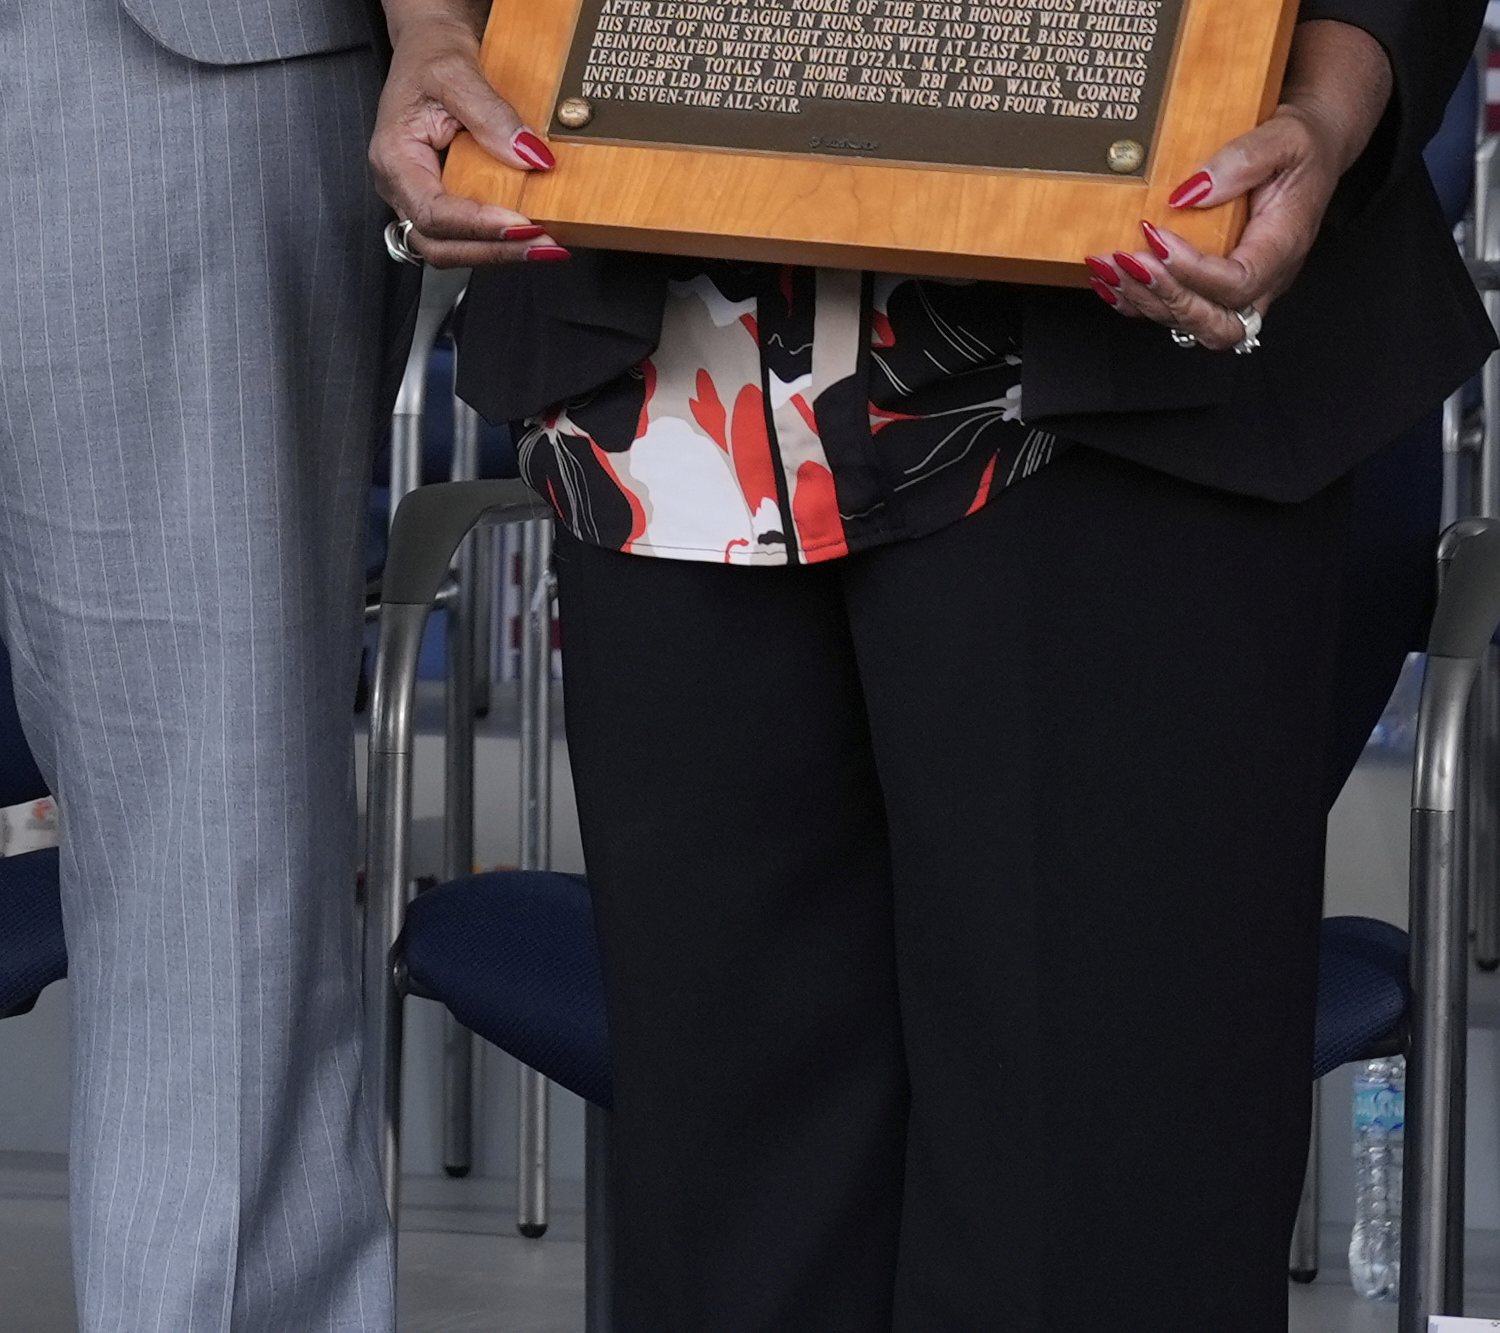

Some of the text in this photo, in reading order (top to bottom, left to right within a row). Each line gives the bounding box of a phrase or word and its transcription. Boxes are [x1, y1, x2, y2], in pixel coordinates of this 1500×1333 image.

[581, 82, 801, 113] WAS A SEVEN-TIME ALL-STAR.
